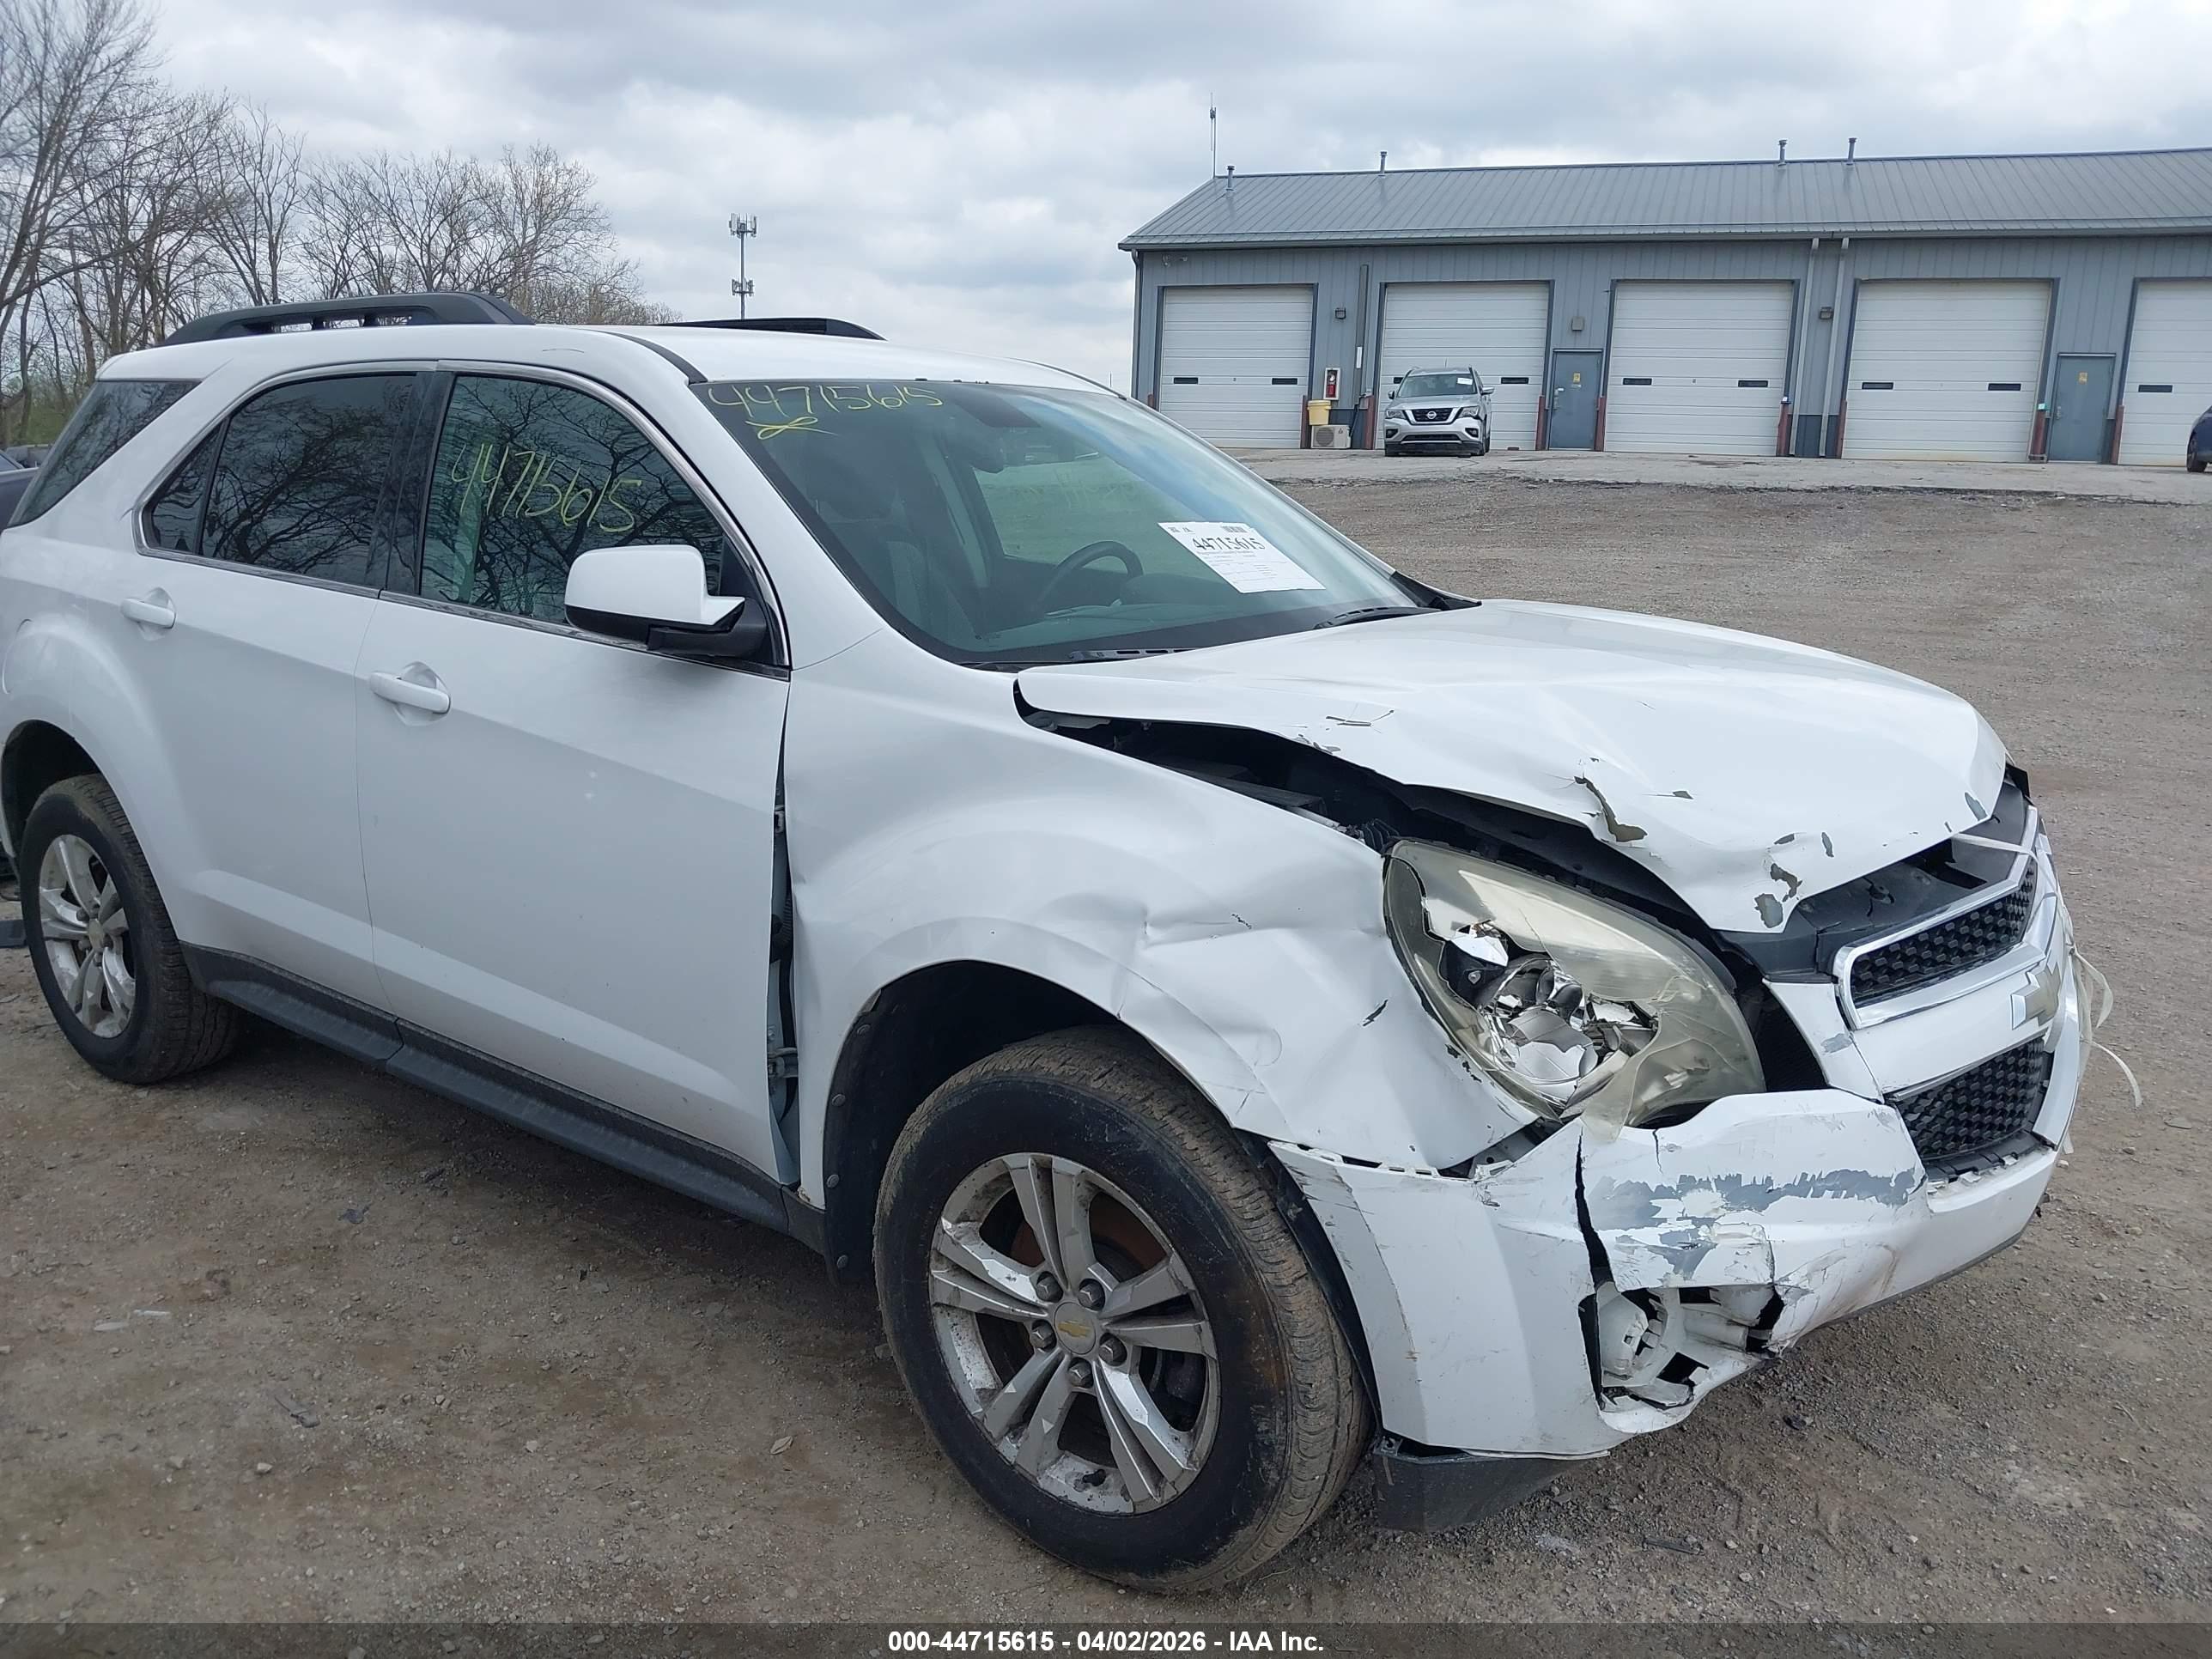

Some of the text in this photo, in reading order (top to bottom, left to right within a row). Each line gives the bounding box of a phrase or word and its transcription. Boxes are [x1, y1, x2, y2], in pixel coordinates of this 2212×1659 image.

[708, 384, 944, 417] 44715615
[451, 442, 642, 532] 44715615
[1192, 537, 1266, 550] 44715615
